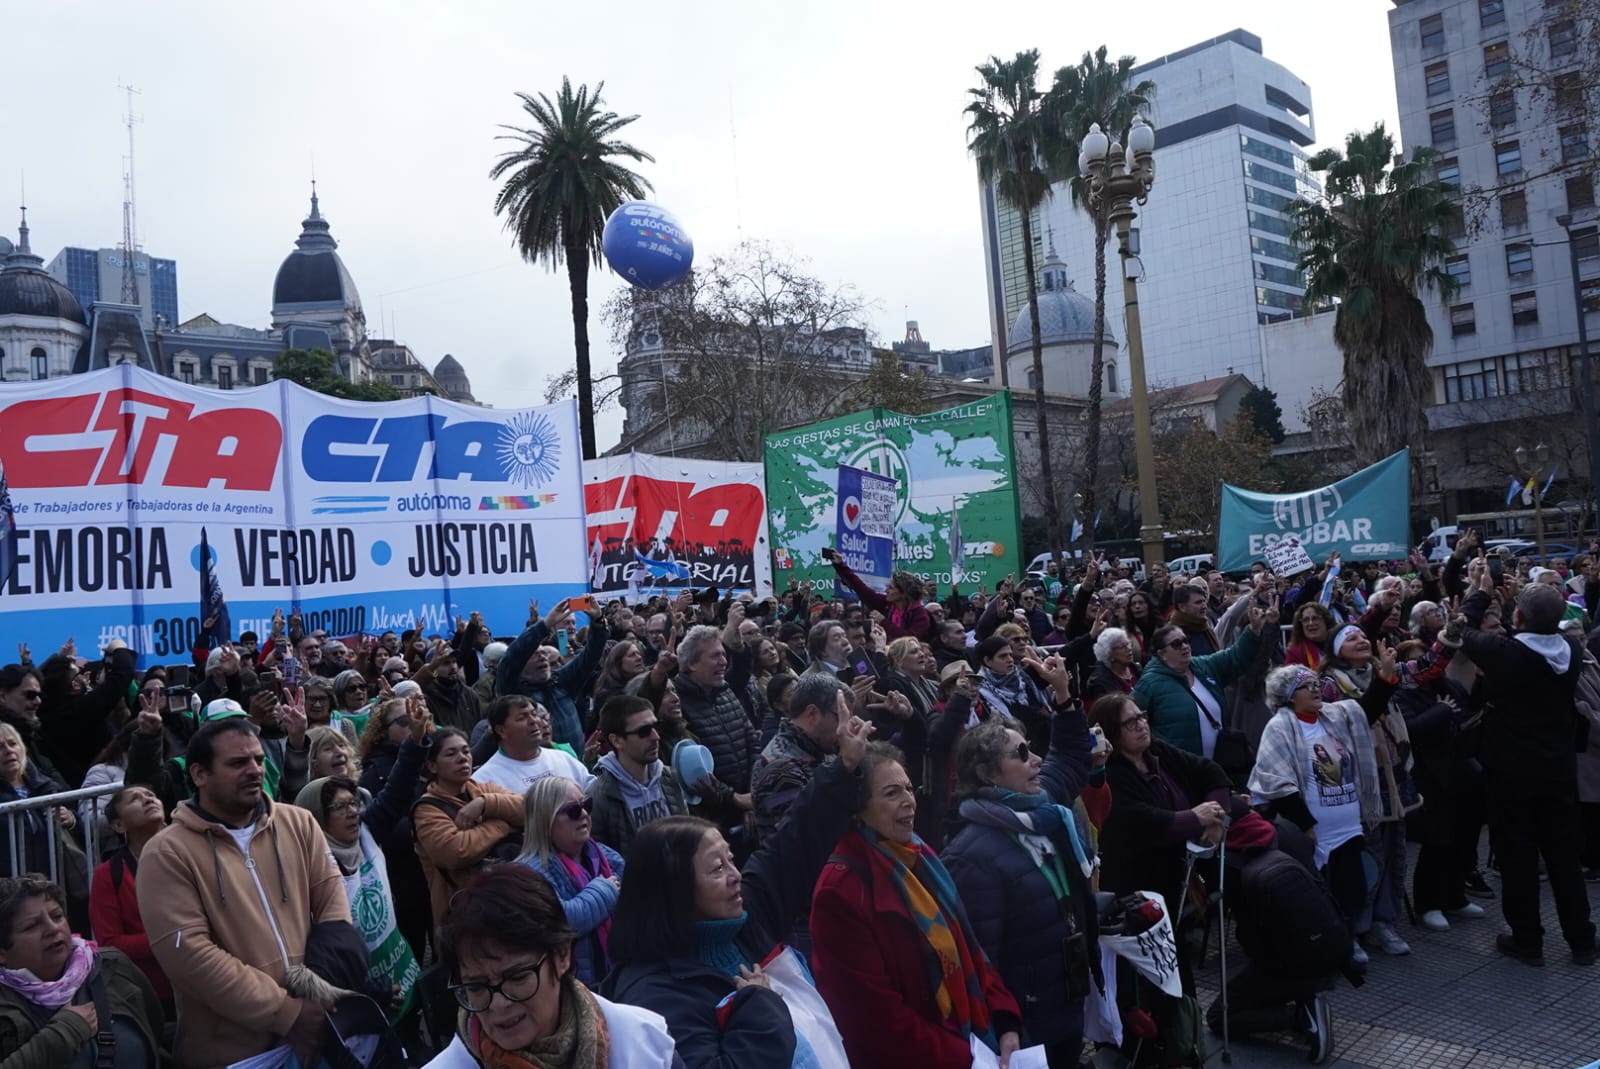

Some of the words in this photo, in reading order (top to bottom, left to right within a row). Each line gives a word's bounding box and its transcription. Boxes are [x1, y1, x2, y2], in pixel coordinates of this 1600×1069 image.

[0, 387, 283, 491] CTA
[301, 413, 515, 483] CTA
[793, 427, 841, 446] GESTAS
[844, 423, 861, 436] SE
[12, 502, 29, 514] de
[33, 501, 113, 514] Trabajadores
[116, 502, 123, 512] y
[127, 500, 193, 513] Trabajadoras
[195, 502, 209, 512] de
[212, 502, 222, 512] la
[224, 503, 273, 515] Argentina
[397, 493, 471, 512] autónoma
[234, 528, 356, 587] VERDAD
[408, 522, 538, 578] JUSTICIA
[841, 532, 868, 553] Salud
[5, 527, 172, 596] EMORIA
[841, 553, 875, 573] Pública
[933, 571, 987, 584] TOXS”
[97, 616, 201, 657] #SON300
